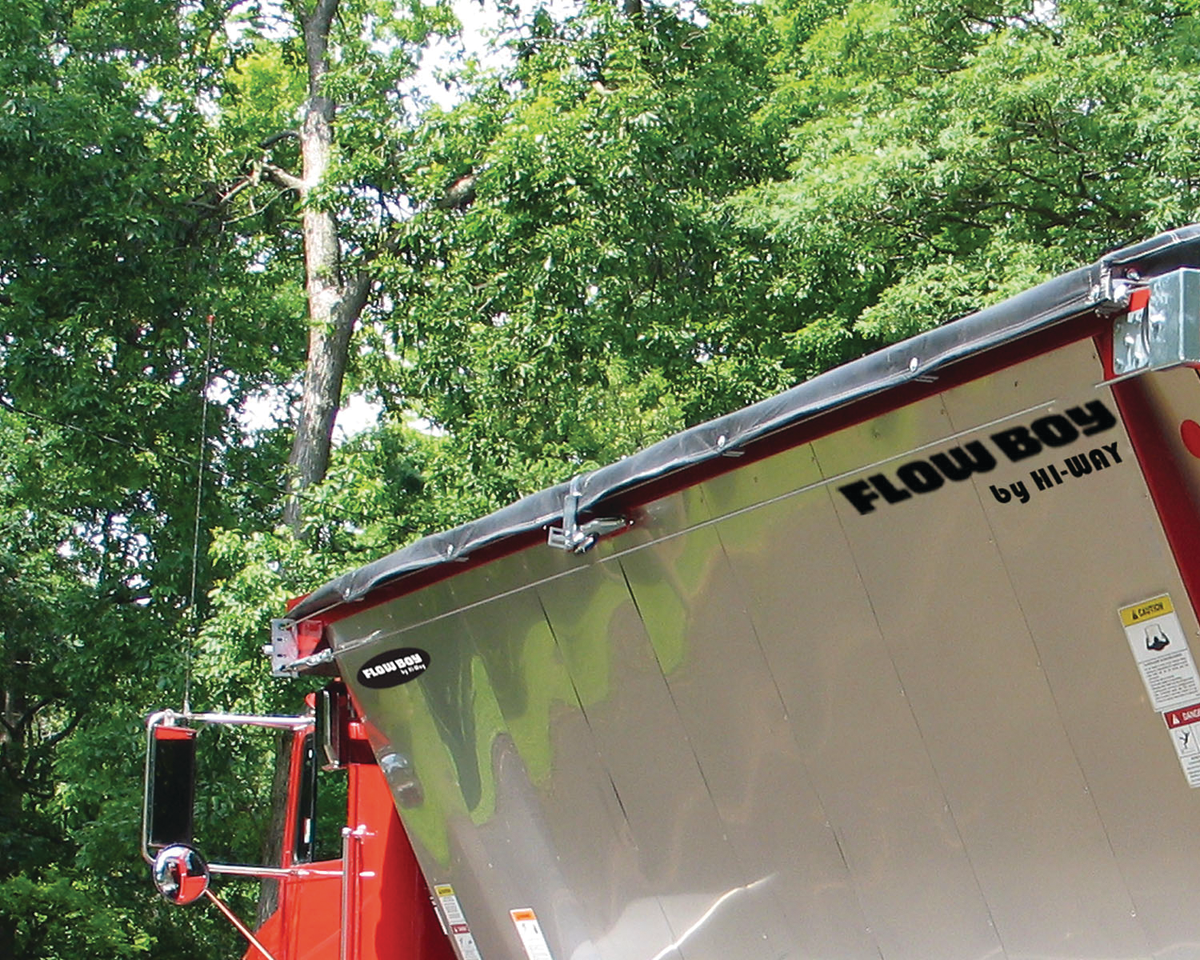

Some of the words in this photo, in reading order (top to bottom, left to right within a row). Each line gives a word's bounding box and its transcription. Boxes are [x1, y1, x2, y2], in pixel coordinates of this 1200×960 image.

[837, 439, 997, 516] FLOW
[989, 399, 1117, 463] BOY
[989, 473, 1031, 504] by
[1029, 441, 1123, 492] HI-WAY
[1137, 602, 1165, 618] CAUTION
[362, 660, 398, 680] FLOW
[394, 653, 423, 669] BOY
